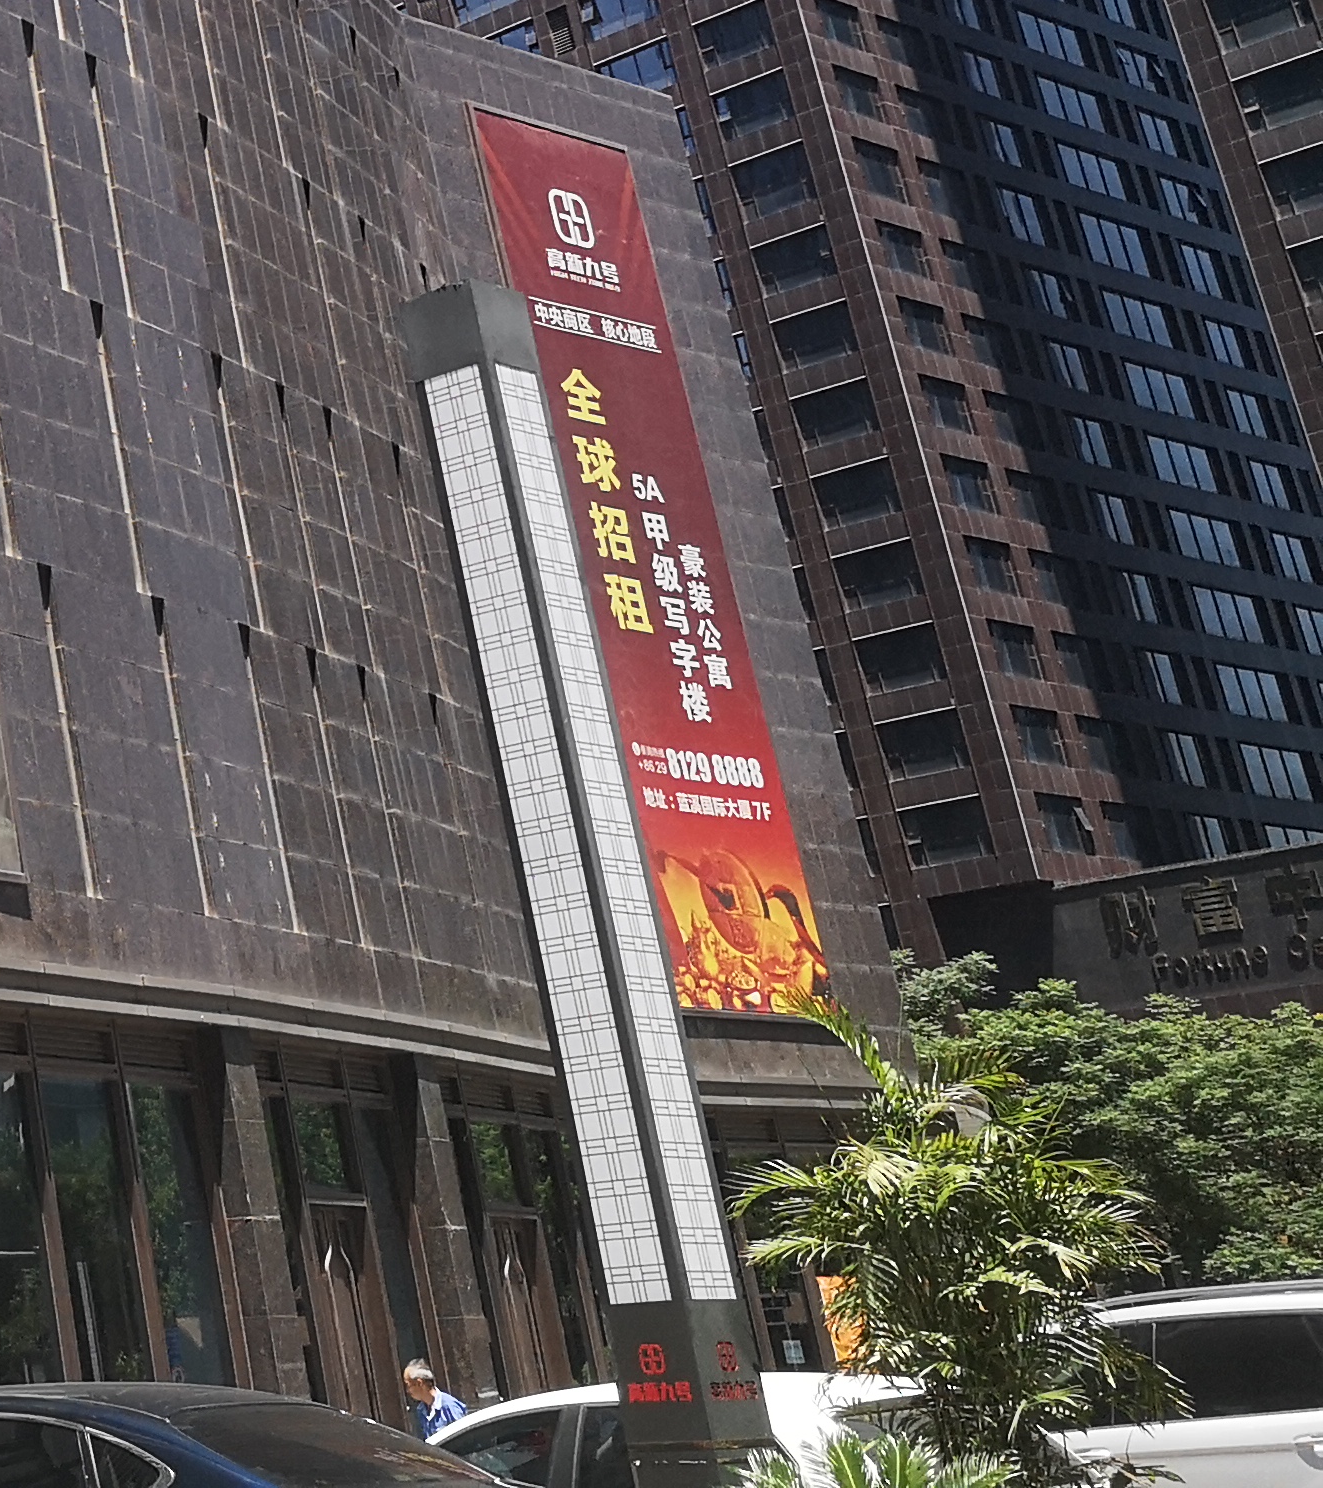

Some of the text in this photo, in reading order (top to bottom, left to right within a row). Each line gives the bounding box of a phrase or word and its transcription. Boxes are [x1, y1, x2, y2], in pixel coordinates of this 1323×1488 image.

[545, 248, 620, 285] 高新九号
[560, 368, 655, 636] 全球招租
[678, 543, 732, 690] 豪装公寓
[666, 748, 712, 783] 8129
[711, 755, 765, 789] 8888
[627, 1380, 693, 1403] 高新九号
